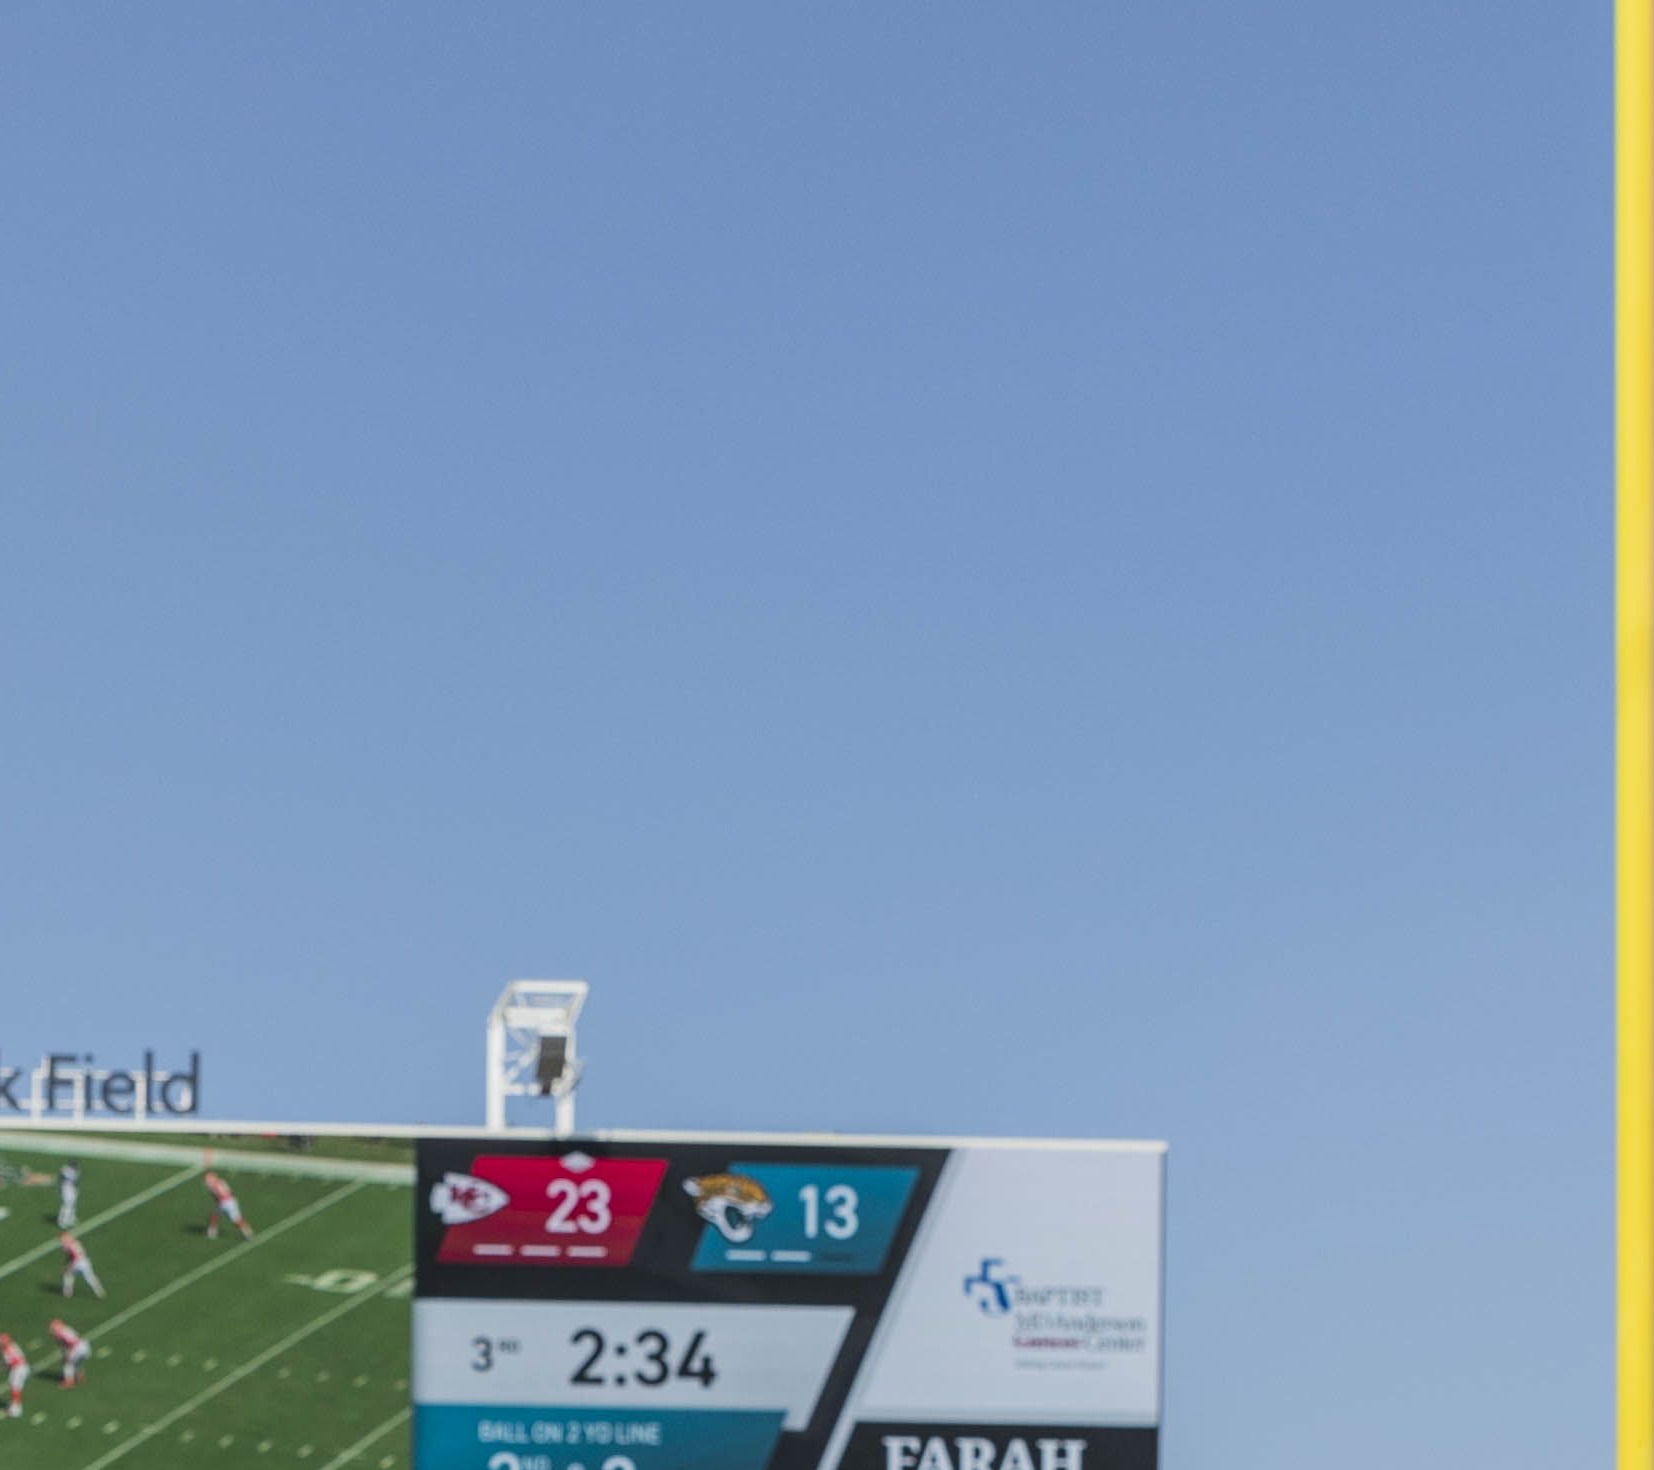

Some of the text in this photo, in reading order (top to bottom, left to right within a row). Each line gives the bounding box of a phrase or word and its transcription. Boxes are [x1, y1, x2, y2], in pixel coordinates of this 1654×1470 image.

[44, 1051, 201, 1116] Field
[544, 1177, 612, 1235] 23
[798, 1184, 859, 1240] 13
[569, 1330, 717, 1389] 2:34
[478, 1420, 529, 1445] BALL
[614, 1422, 662, 1447] LINE
